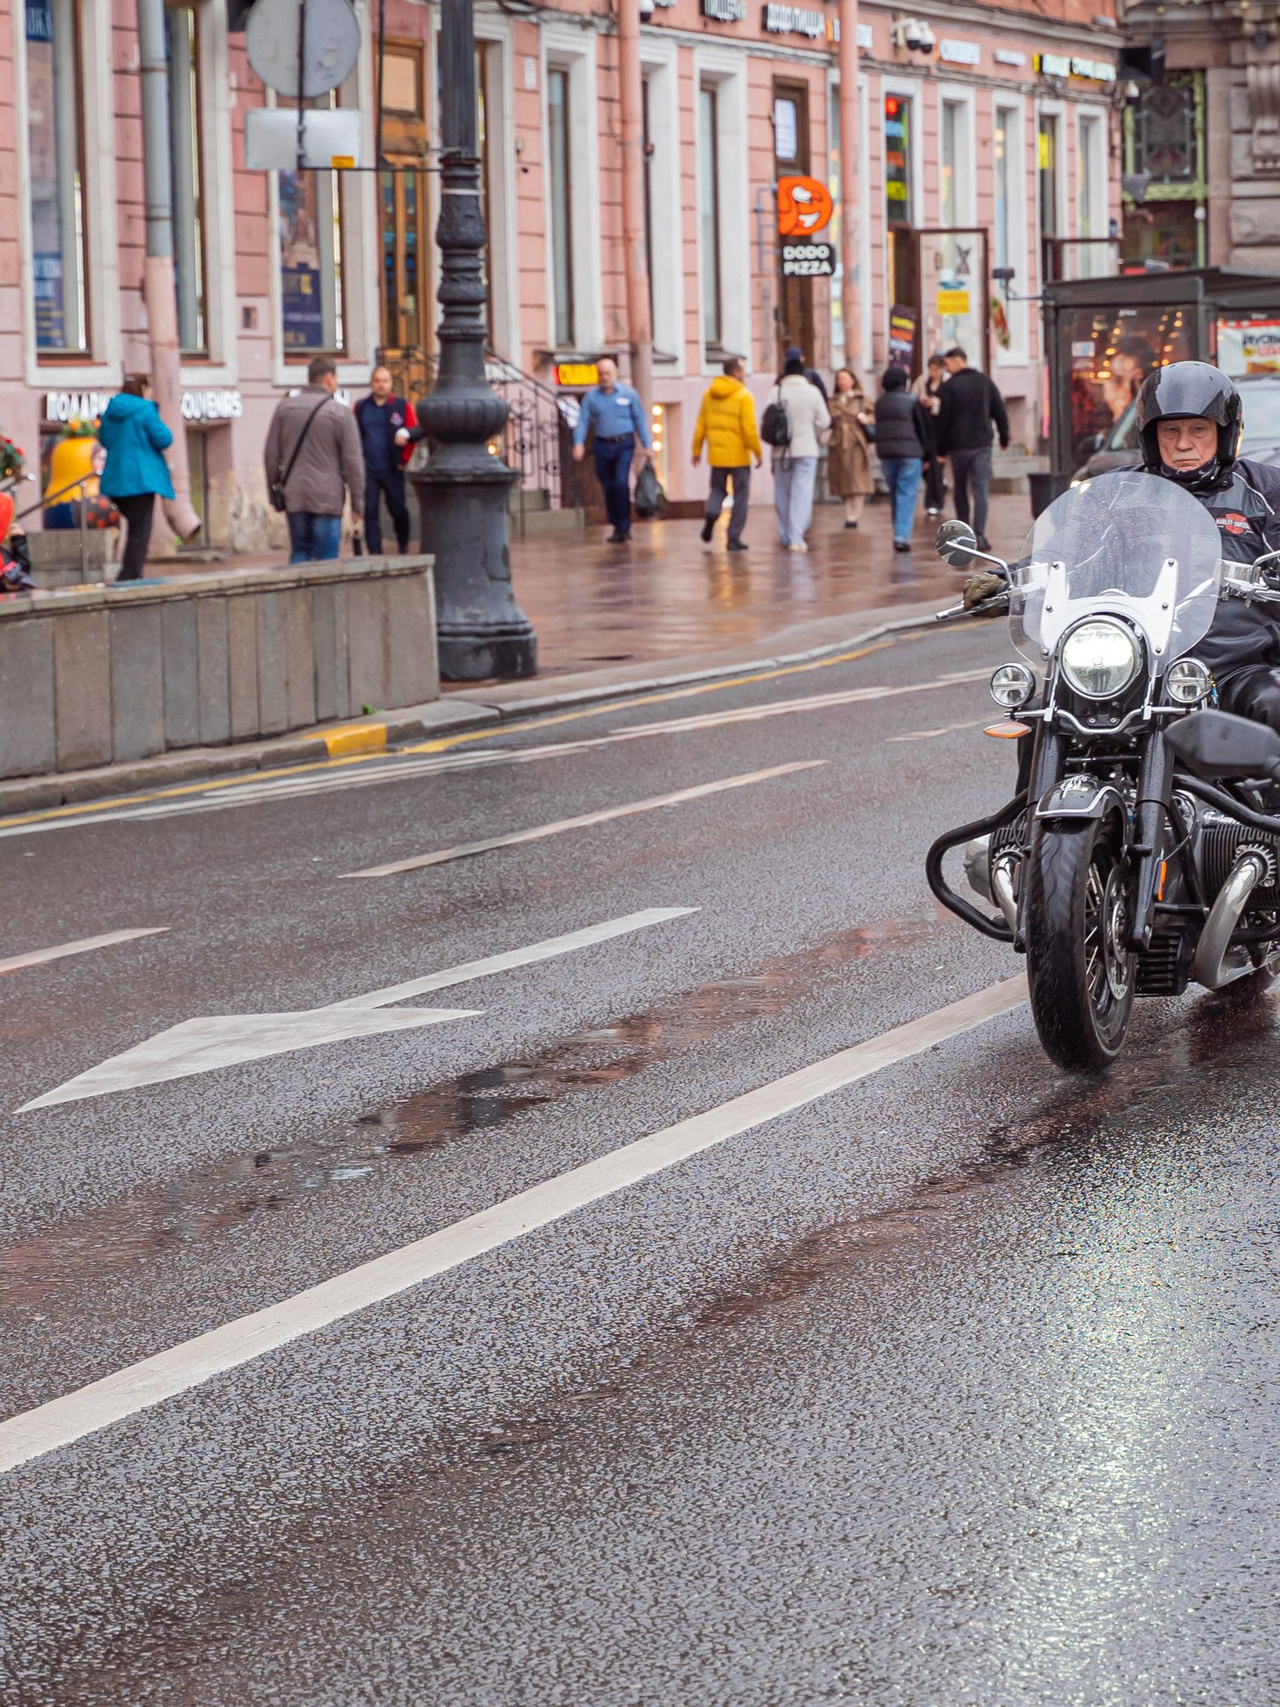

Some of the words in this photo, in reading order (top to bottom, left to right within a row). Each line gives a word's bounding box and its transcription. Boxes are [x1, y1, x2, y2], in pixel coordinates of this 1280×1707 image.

[783, 245, 830, 260] DODO
[783, 260, 832, 275] PIZZA
[181, 391, 243, 418] OUVENIRS
